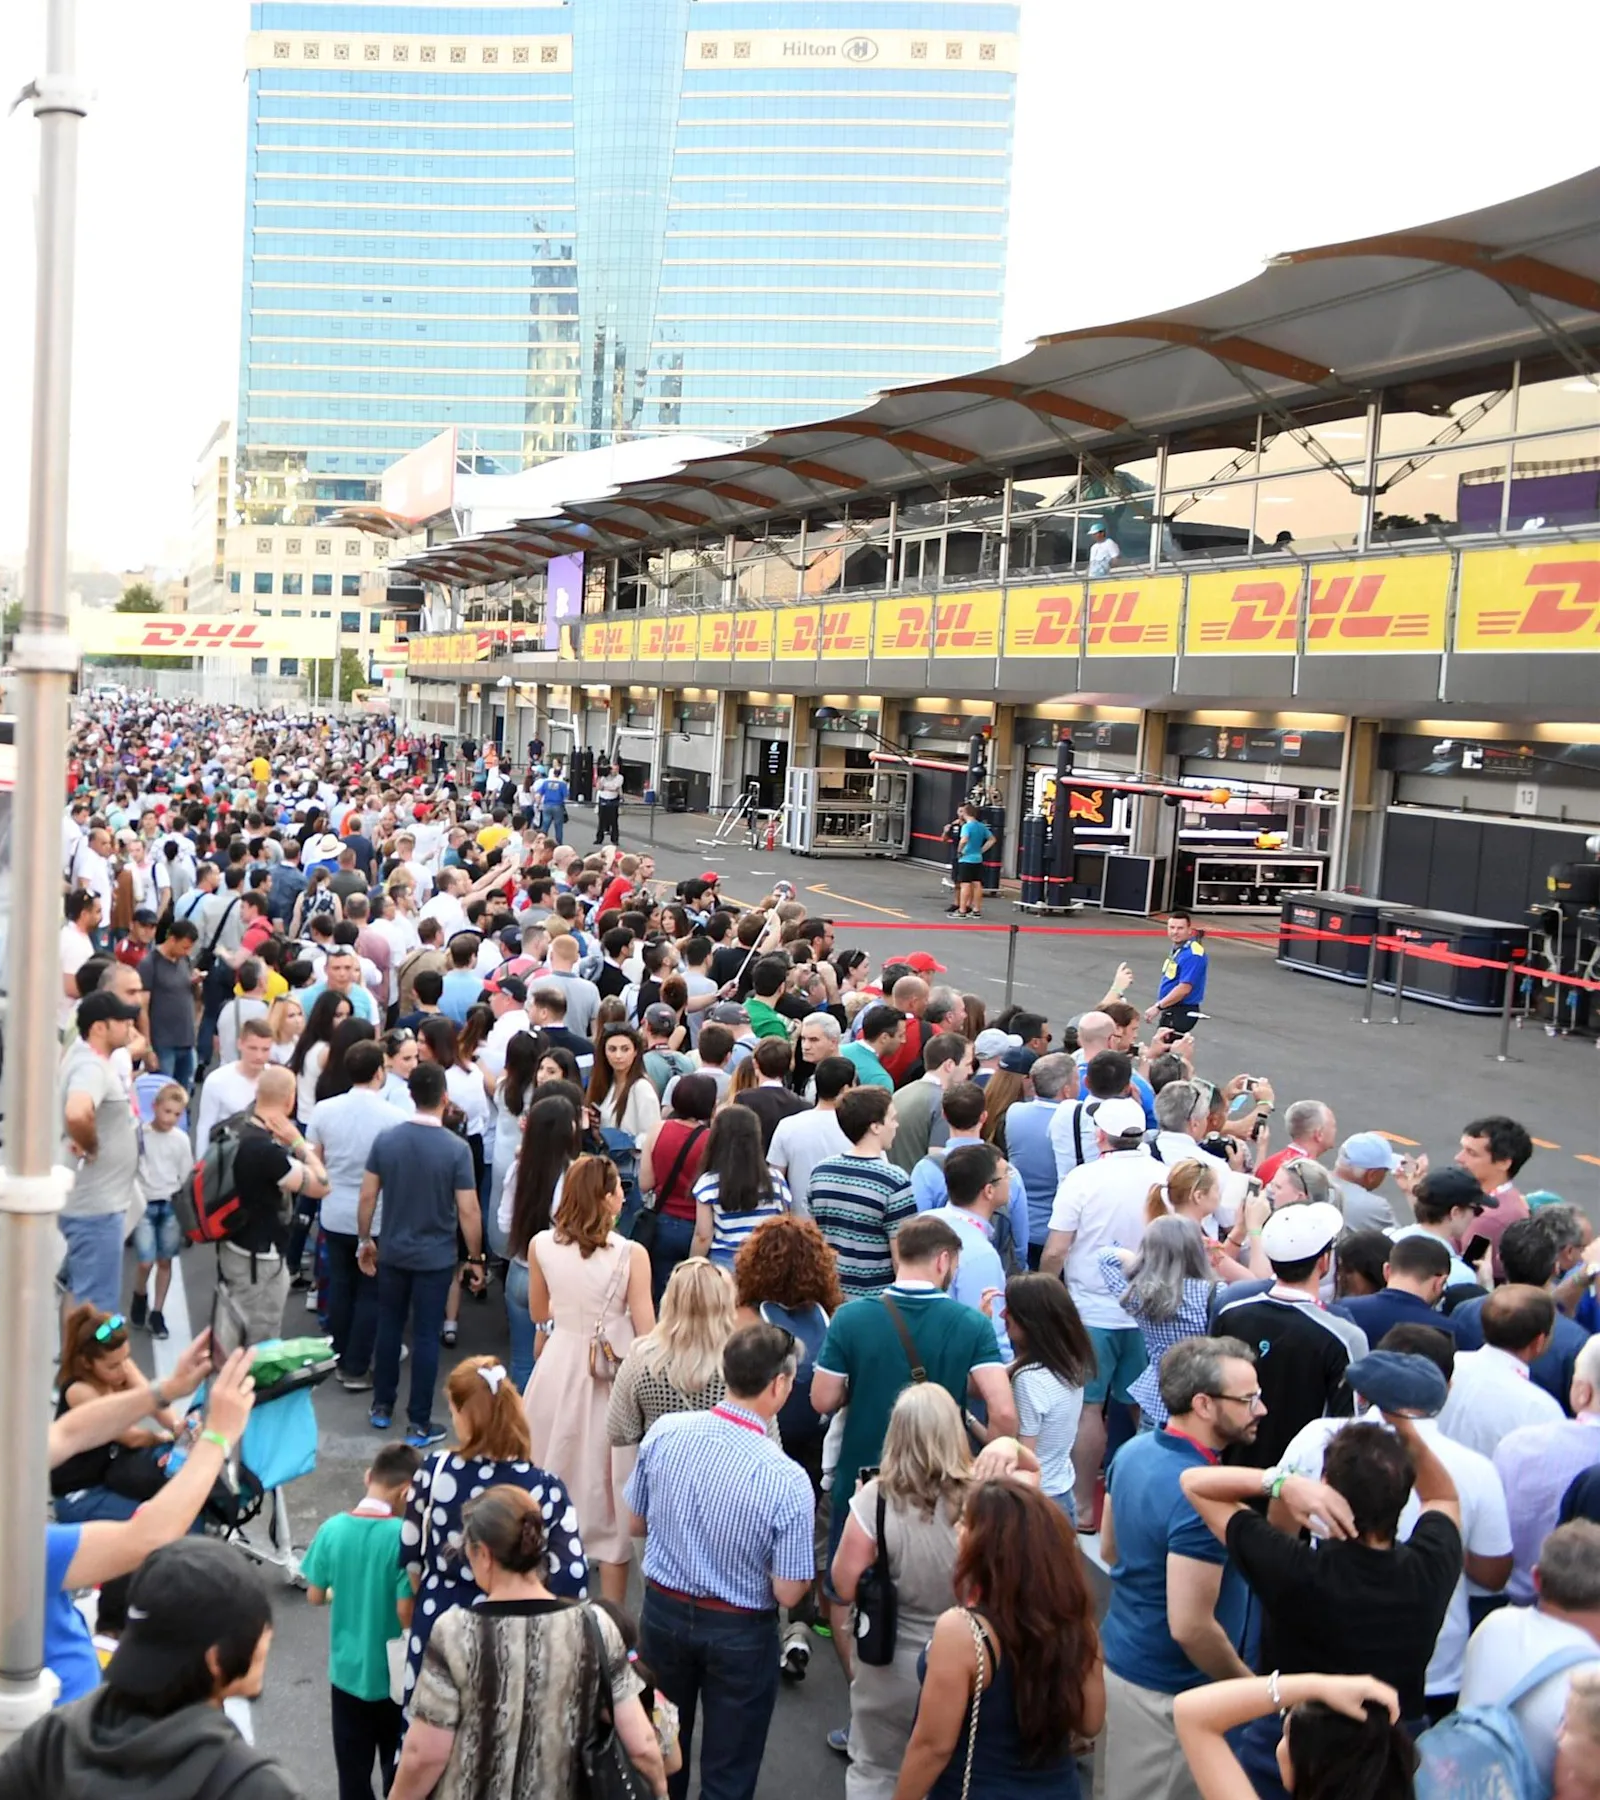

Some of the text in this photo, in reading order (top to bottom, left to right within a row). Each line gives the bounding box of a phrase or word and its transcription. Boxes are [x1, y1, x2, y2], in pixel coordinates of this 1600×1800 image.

[783, 41, 836, 56] Hilton
[1032, 591, 1145, 645] DHL
[1226, 575, 1394, 641] DHL
[141, 623, 264, 648] DHL
[593, 627, 624, 654] DHL
[649, 624, 686, 653] DHL
[712, 620, 759, 652] DHL
[792, 612, 853, 651] DHL
[896, 604, 976, 648] DHL
[1521, 790, 1533, 804] 13
